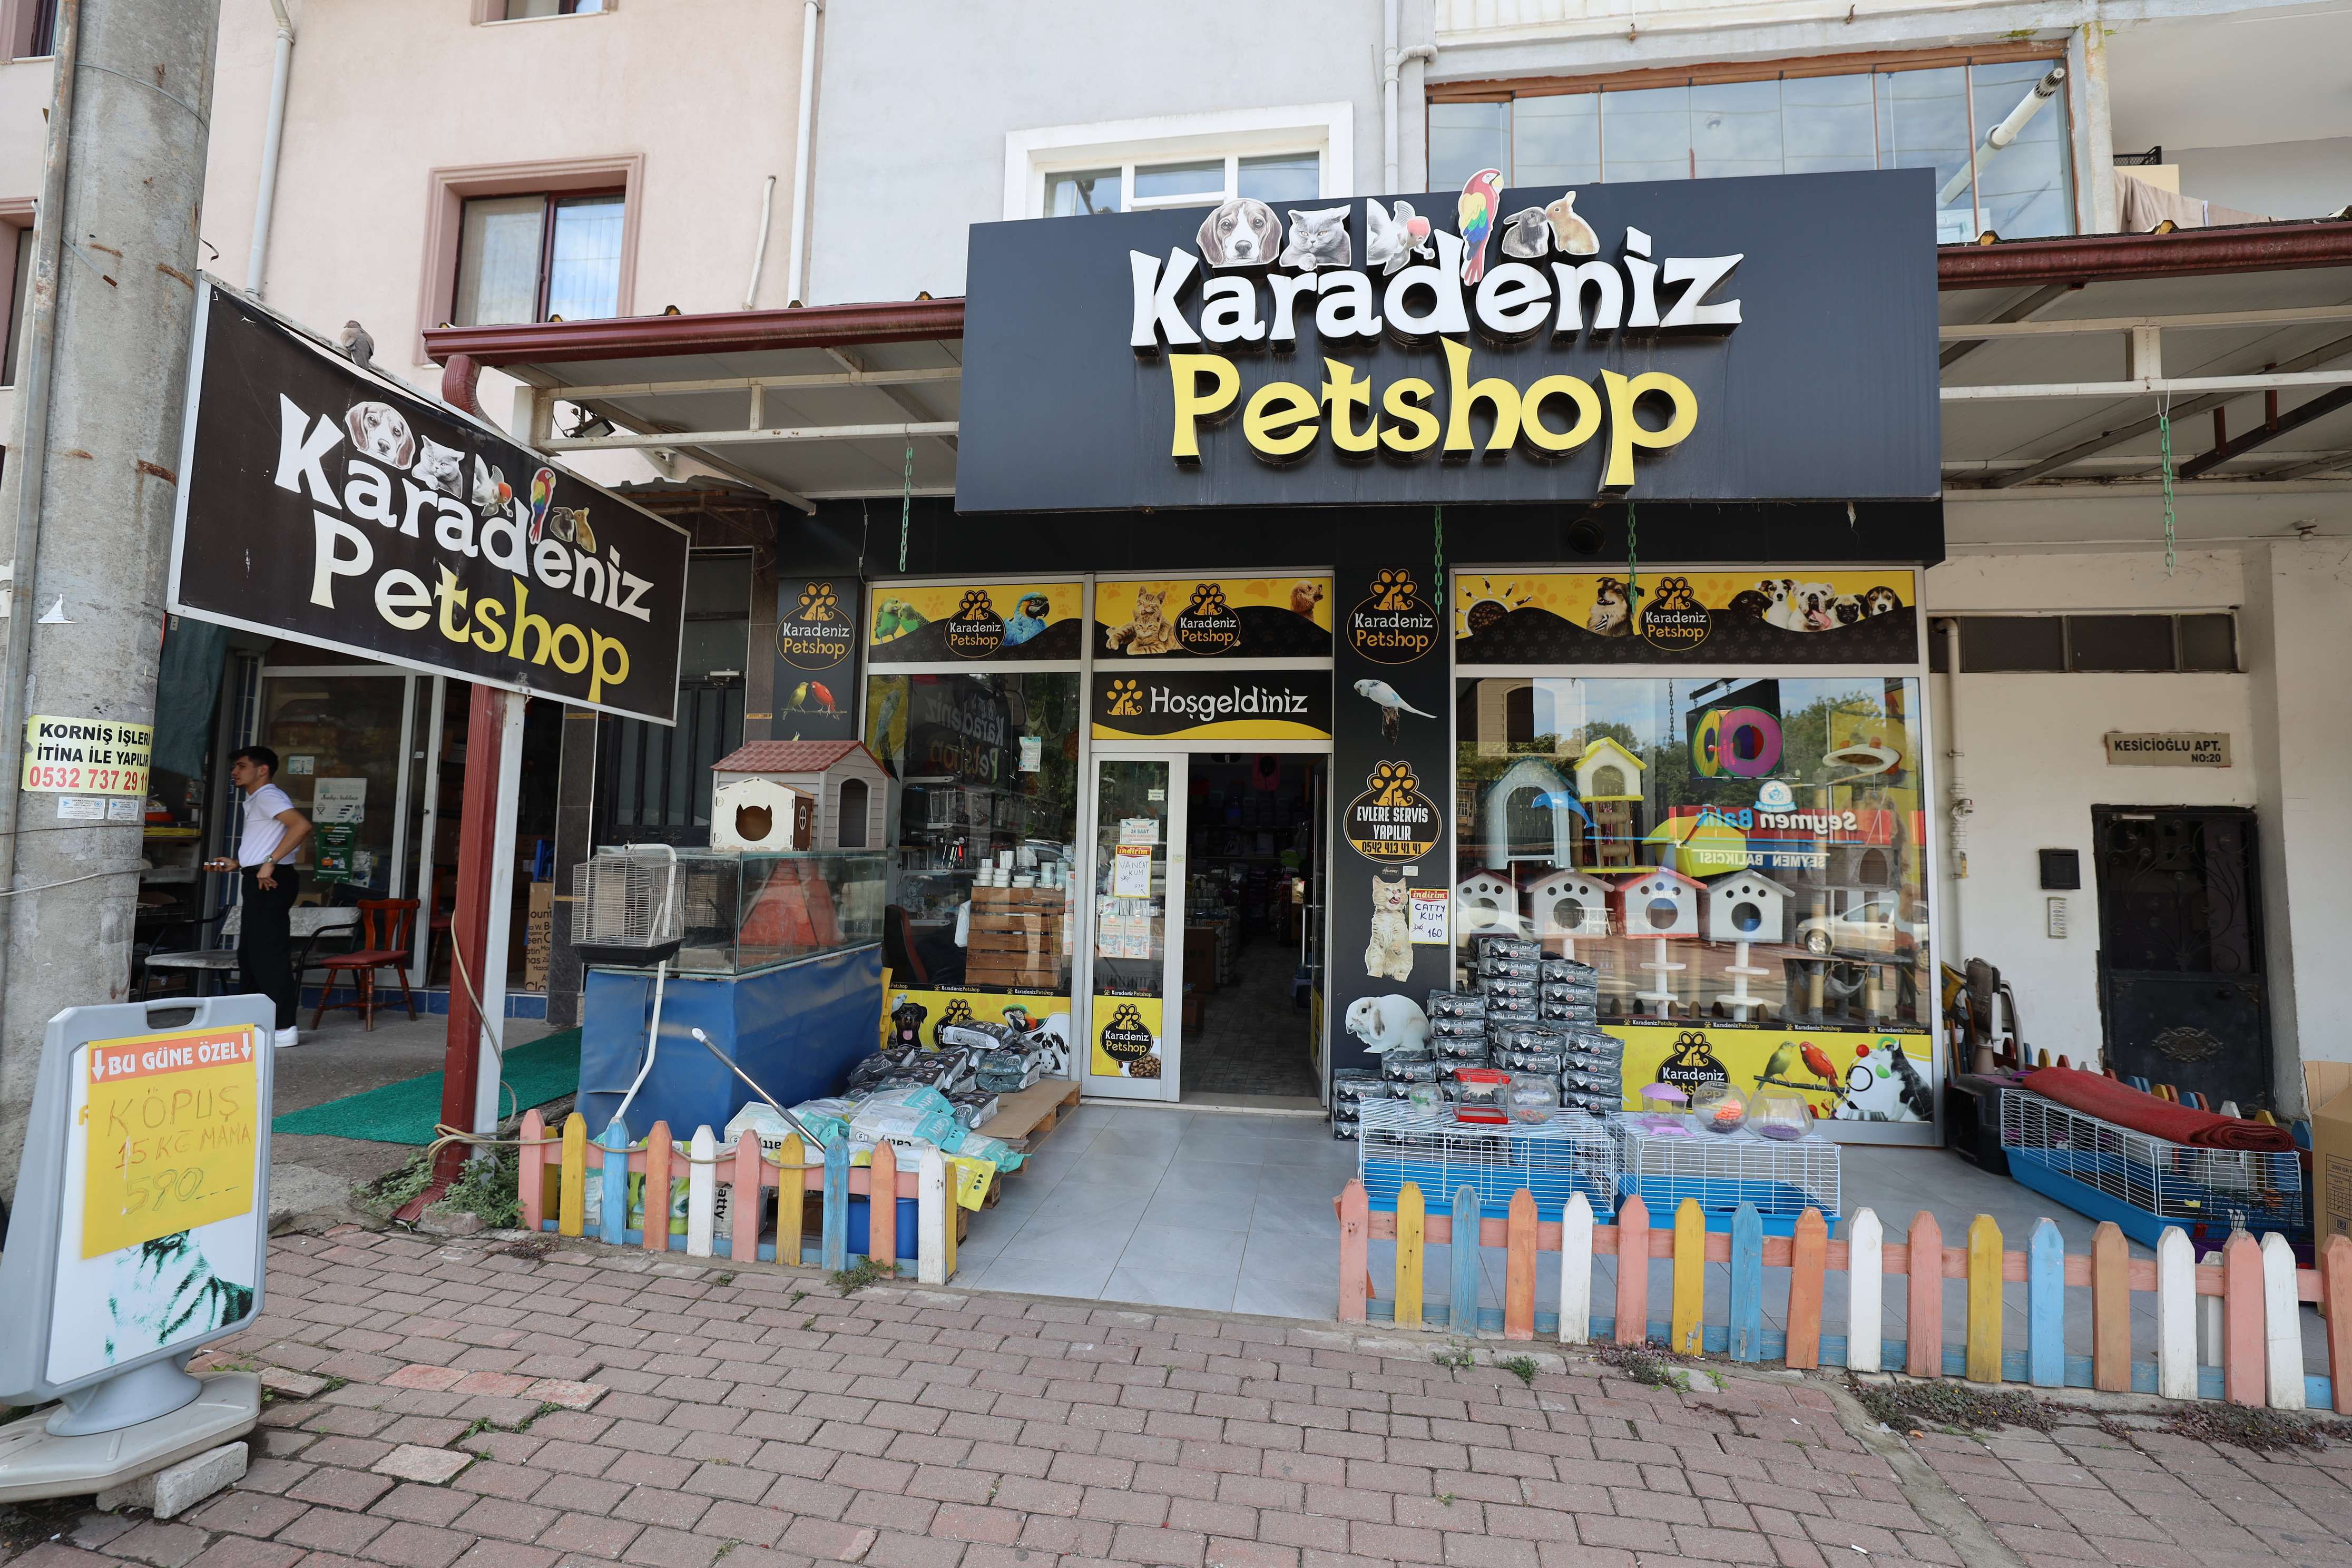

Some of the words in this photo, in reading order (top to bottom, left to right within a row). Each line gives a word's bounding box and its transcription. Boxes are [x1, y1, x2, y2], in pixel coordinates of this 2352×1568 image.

[1129, 227, 1743, 352] Karadeniz
[1168, 337, 1698, 490] Petshop
[274, 393, 654, 622] Karadeniz
[310, 509, 629, 703] Petshop
[1180, 616, 1237, 629] Karadeniz
[1355, 613, 1433, 629] Karadeniz
[1645, 611, 1707, 626] Karadeniz
[783, 621, 849, 638] Karadeniz
[949, 622, 1001, 634] Karadeniz
[1648, 625, 1704, 642] Petshop
[950, 633, 998, 649] Petshop
[1181, 629, 1233, 646] Petshop
[1356, 630, 1428, 652] Petshop
[783, 638, 845, 659] Petshop
[1150, 685, 1308, 722] Hoşgeldiniz
[40, 723, 113, 745] KORNİŞ
[118, 726, 151, 747] İŞLERİ
[2114, 738, 2191, 752] KESİCİOĞLU
[2194, 740, 2221, 752] APT.
[37, 743, 83, 762] İTİNA
[89, 746, 112, 764] İLE
[116, 751, 149, 768] YAPILIR
[2191, 753, 2221, 763] NO:20
[30, 766, 80, 788] 0532
[88, 769, 120, 790] 737
[124, 771, 138, 791] 29
[1357, 806, 1390, 822] EVLERE
[1393, 804, 1429, 823] SERVİS
[1373, 824, 1412, 841] YAPILIR
[1362, 841, 1382, 853] 0542
[1385, 842, 1398, 854] 413
[1401, 843, 1410, 854] 41
[1413, 843, 1422, 855] 41
[1415, 904, 1445, 913] CATTY
[1420, 912, 1443, 921] KUM
[1428, 928, 1443, 938] 160
[1105, 1030, 1149, 1042] Karadeniz
[1106, 1040, 1147, 1055] Petshop
[108, 1055, 135, 1076] BU
[142, 1046, 193, 1069] GÜNE
[198, 1041, 239, 1062] ÖZEL
[1662, 1066, 1726, 1082] Karadeniz
[115, 1138, 149, 1169] 15
[200, 1122, 252, 1151] MAMA
